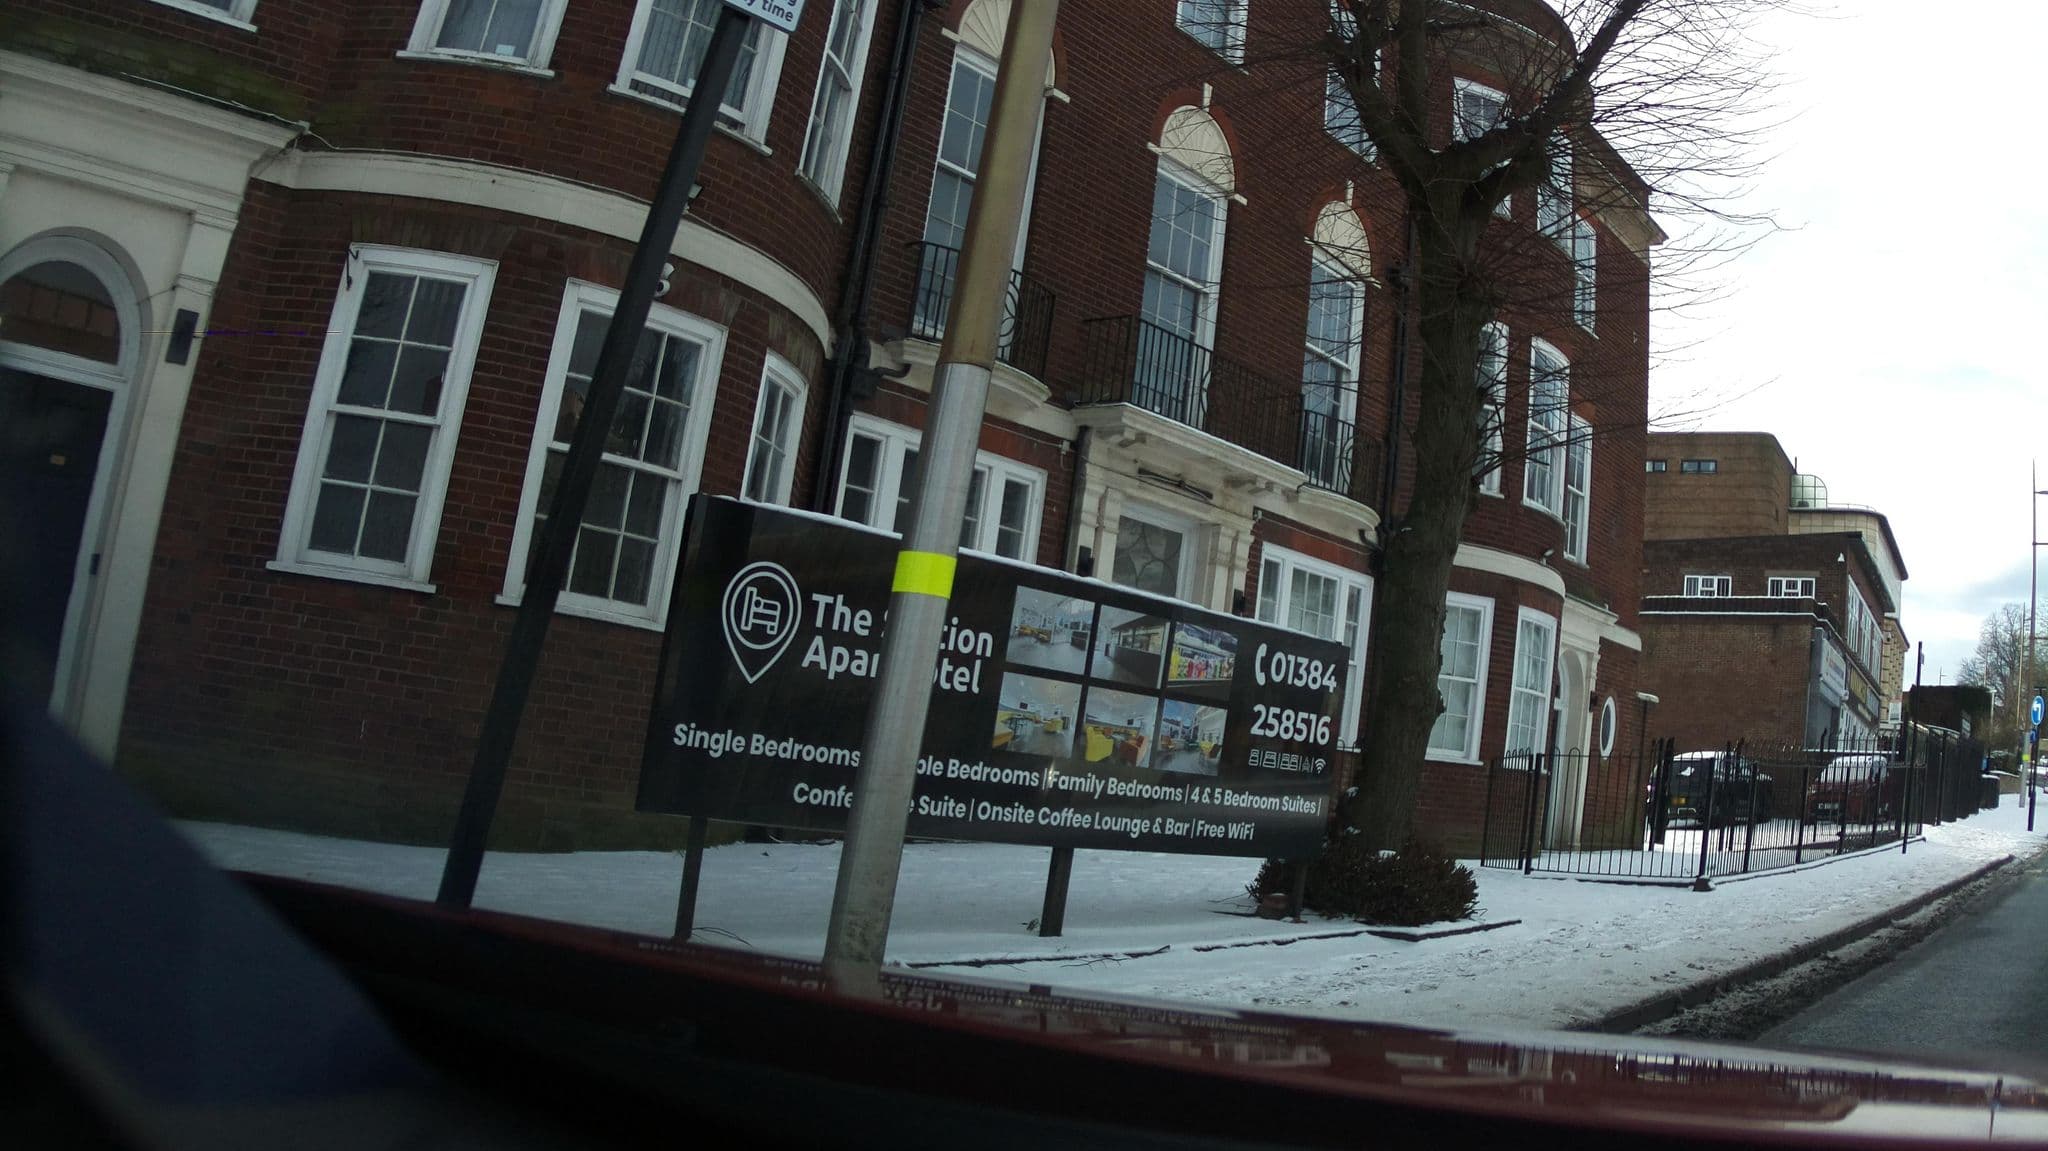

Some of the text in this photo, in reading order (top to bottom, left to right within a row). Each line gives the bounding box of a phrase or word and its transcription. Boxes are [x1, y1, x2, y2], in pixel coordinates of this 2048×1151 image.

[762, 0, 794, 22] time
[812, 593, 873, 637] The
[1270, 651, 1337, 693] 01384
[1249, 704, 1331, 745] 258516
[673, 723, 746, 758] Single
[750, 734, 861, 768] Bedrooms
[947, 758, 1040, 787] Bedrooms
[1050, 771, 1106, 800] Family
[1107, 777, 1183, 802] Bedrooms
[1191, 786, 1201, 802] 4
[1202, 787, 1211, 804] &
[1214, 788, 1223, 805] 5
[1224, 789, 1280, 811] Bedroom
[1281, 795, 1317, 815] Suites
[918, 795, 967, 818] Suite
[977, 800, 1035, 824] Onsite
[1038, 806, 1092, 829] Coffee
[1094, 811, 1151, 839] Lounge
[1153, 817, 1162, 834] &
[1165, 817, 1191, 836] Bar
[1196, 820, 1225, 838] Free
[1228, 822, 1256, 841] WiFi
